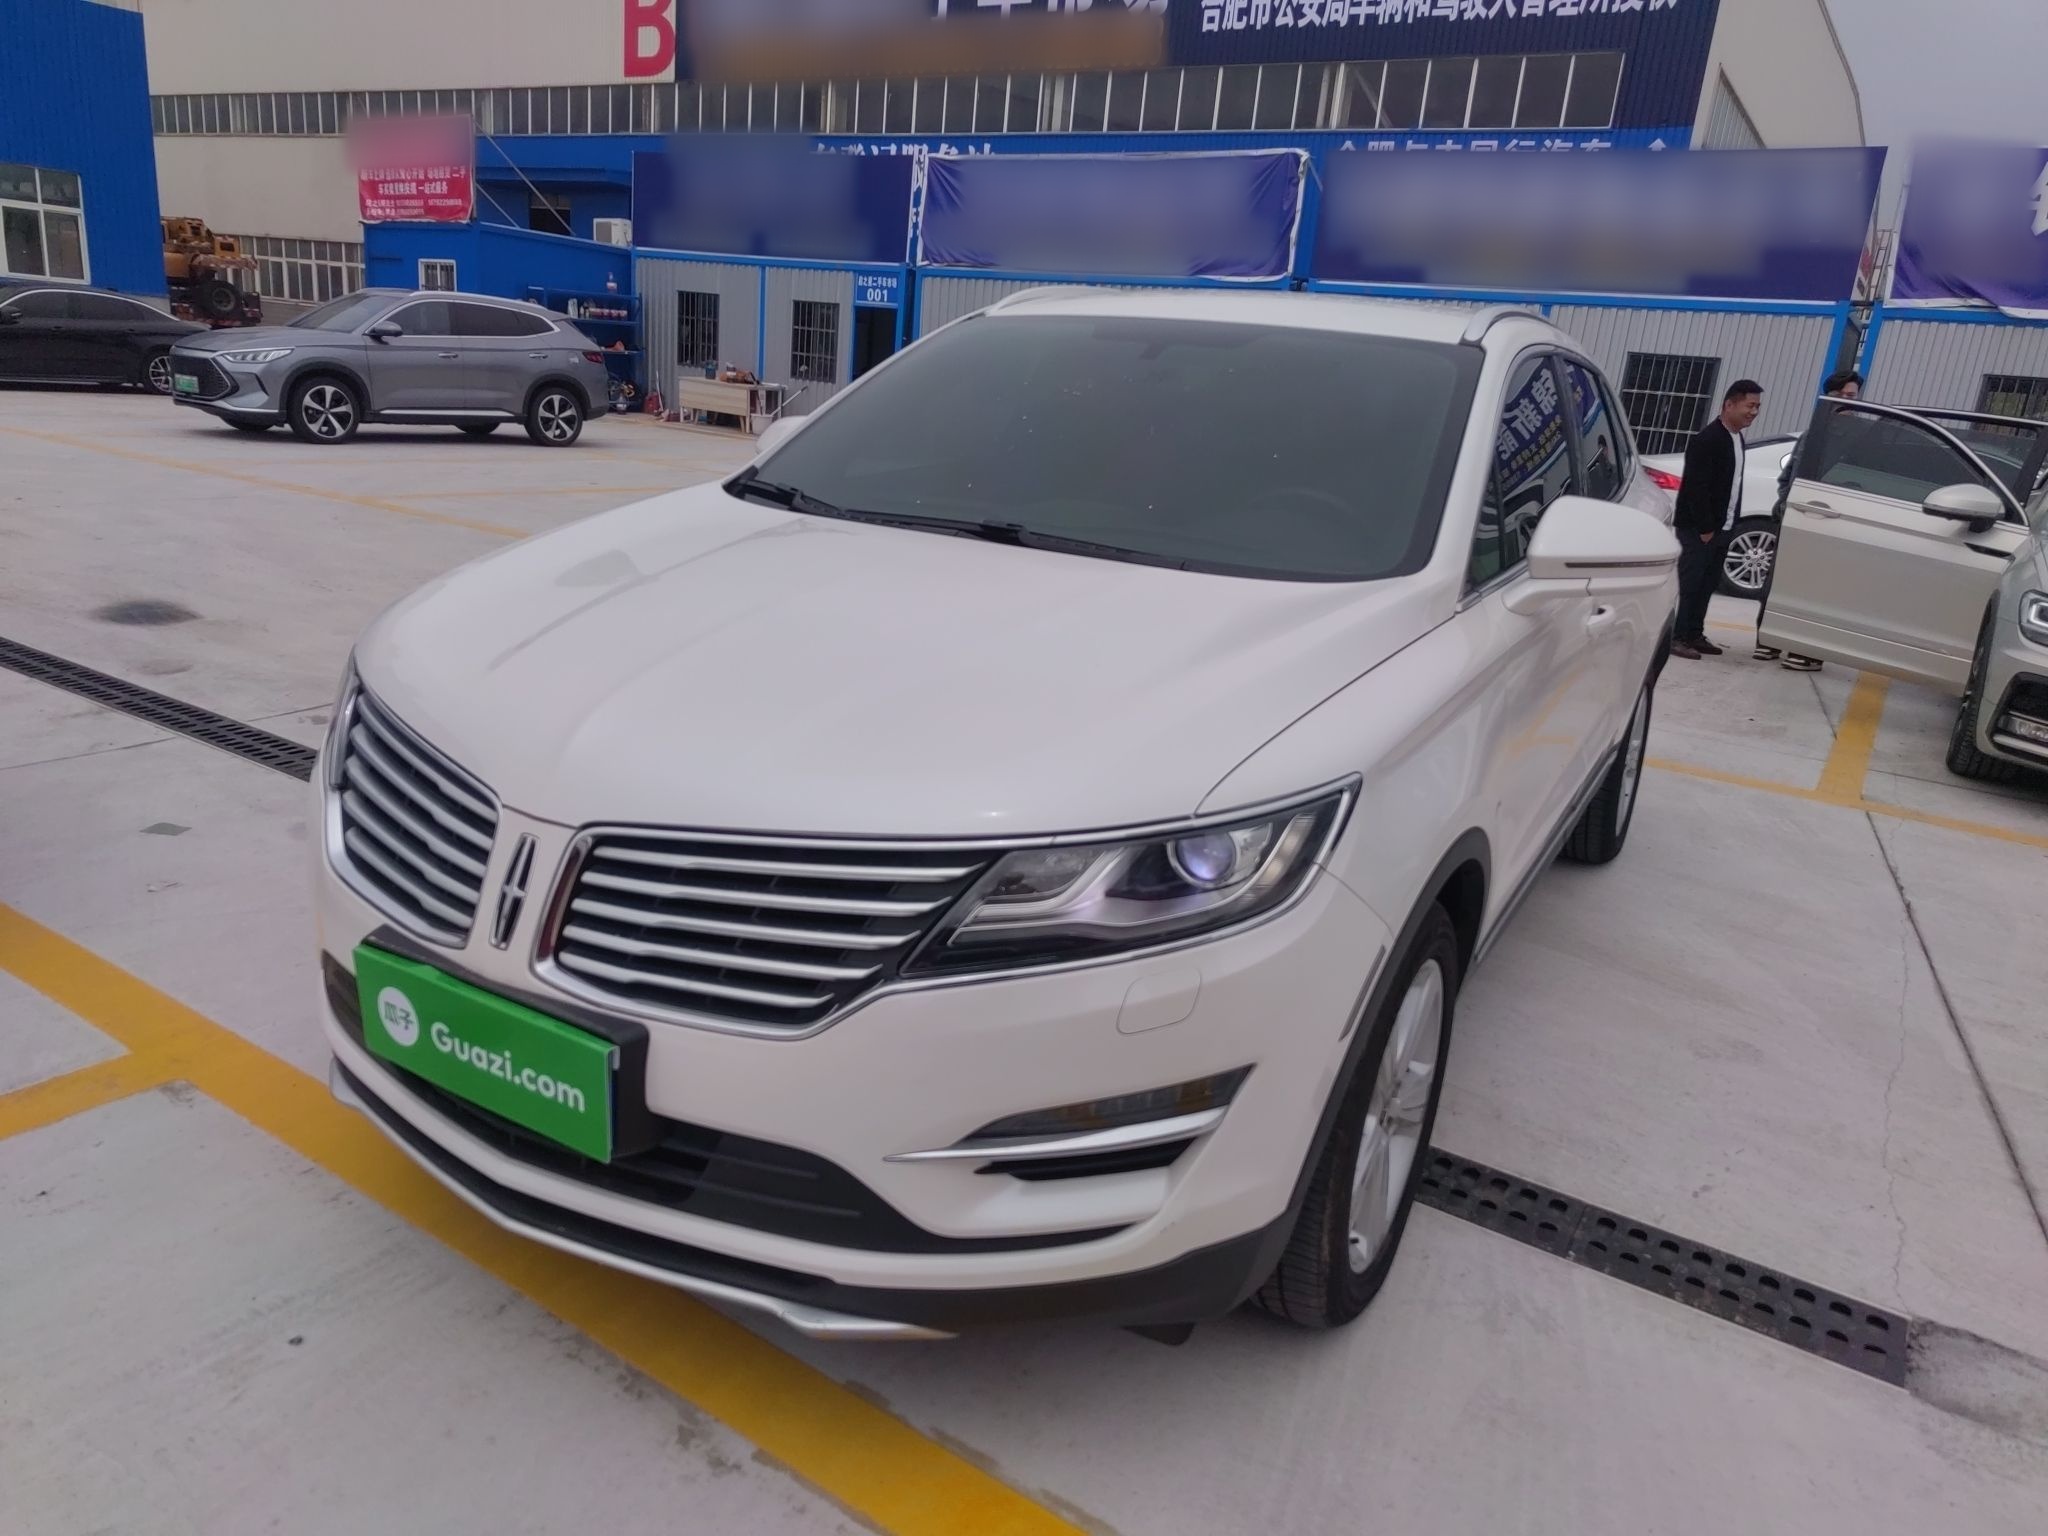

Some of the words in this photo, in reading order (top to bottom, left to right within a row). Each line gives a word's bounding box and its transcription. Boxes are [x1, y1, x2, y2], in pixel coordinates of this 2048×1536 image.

[1201, 0, 1677, 32] 合肥市公安局车辆和驾驶人
[624, 0, 676, 77] B
[867, 288, 888, 302] 001
[384, 1001, 414, 1030] 瓜子
[430, 1021, 586, 1113] Guazi.com
